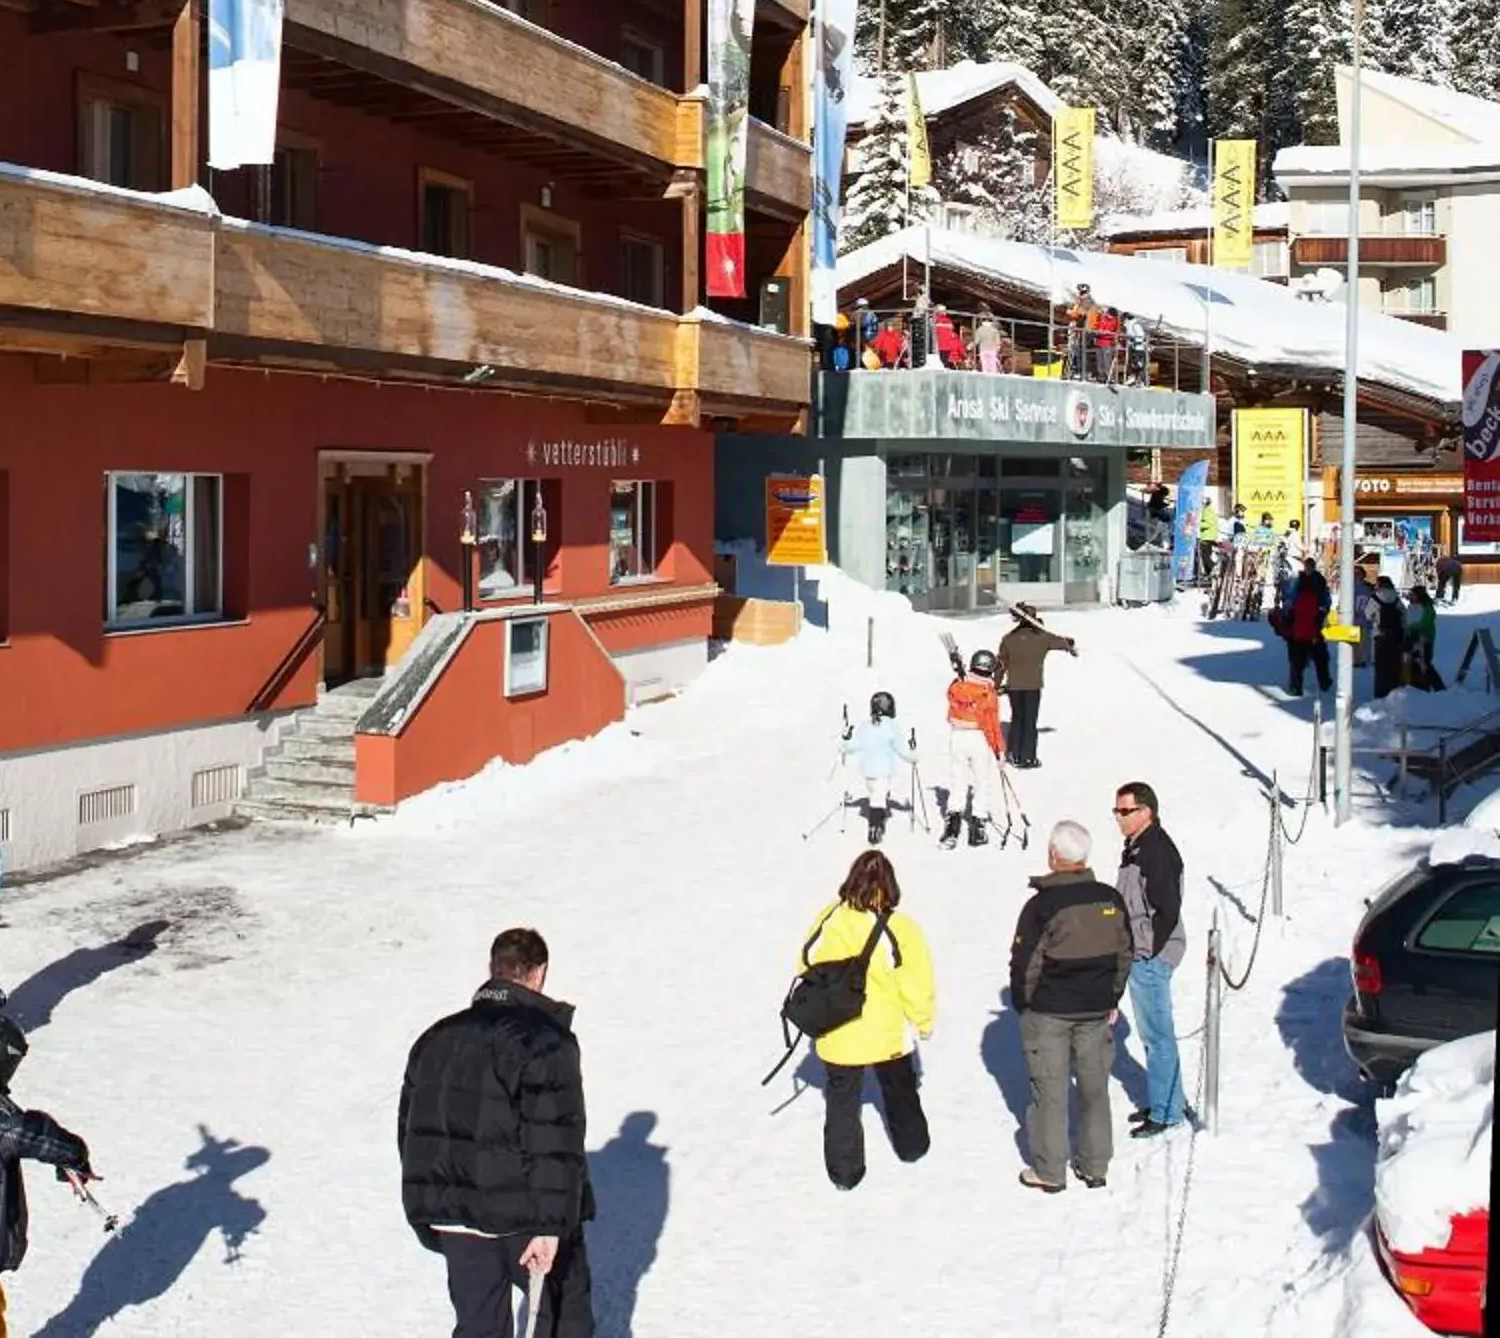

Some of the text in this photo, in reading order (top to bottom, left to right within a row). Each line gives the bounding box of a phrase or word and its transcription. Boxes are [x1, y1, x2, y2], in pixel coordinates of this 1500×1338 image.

[947, 393, 1057, 424] Arosa Ski Service
